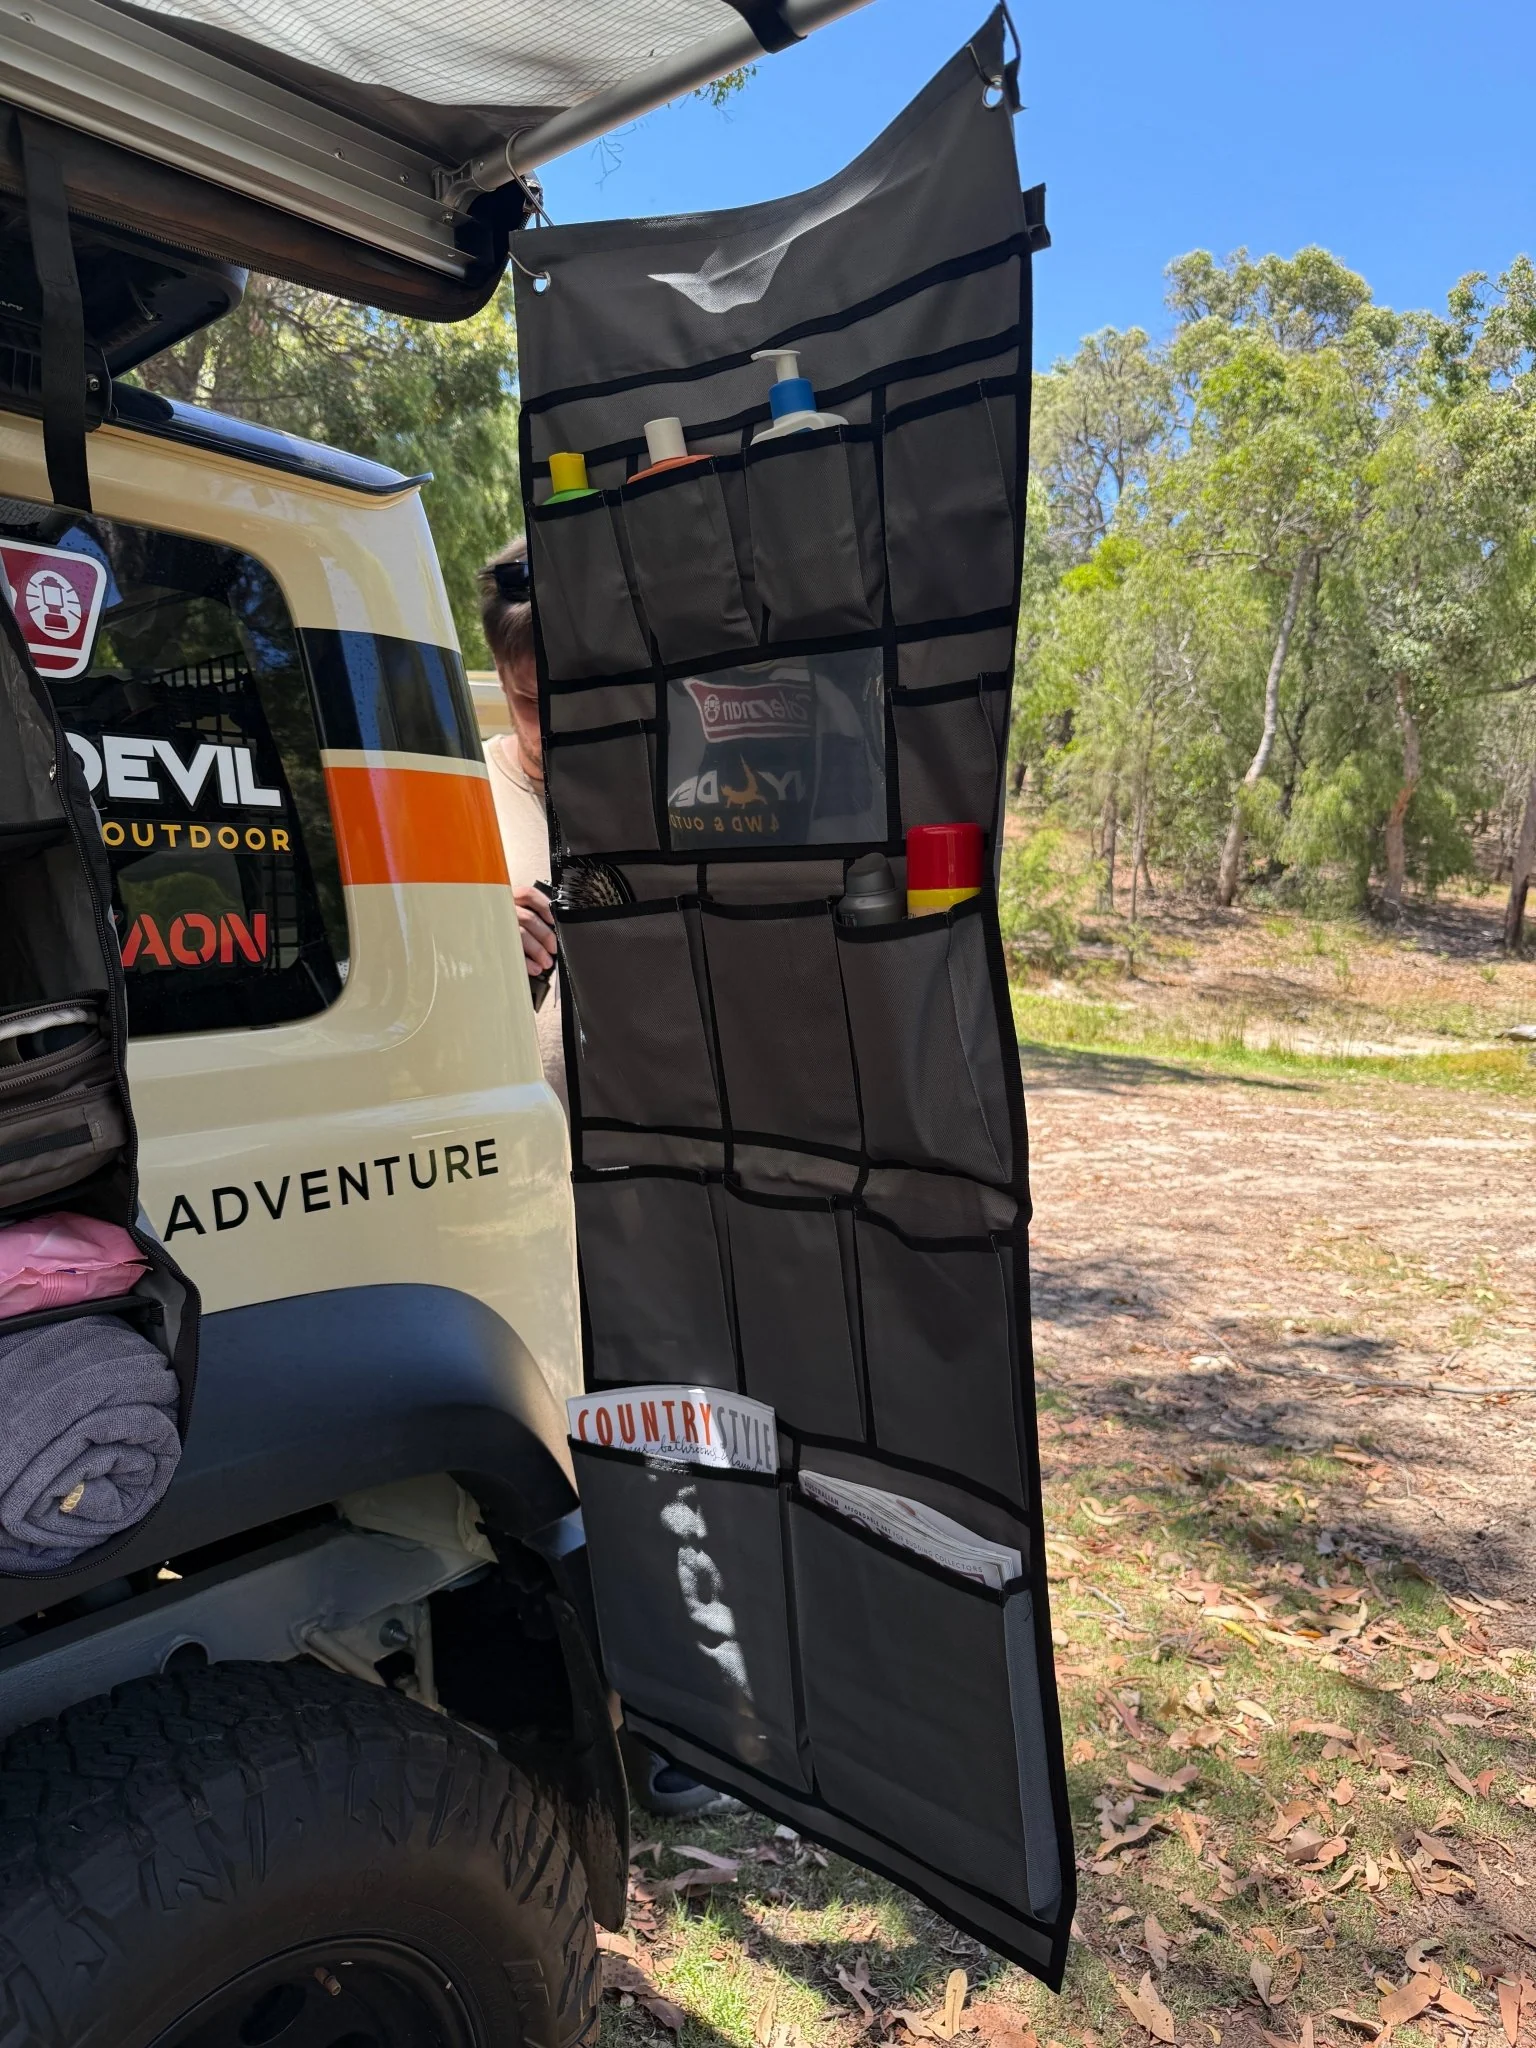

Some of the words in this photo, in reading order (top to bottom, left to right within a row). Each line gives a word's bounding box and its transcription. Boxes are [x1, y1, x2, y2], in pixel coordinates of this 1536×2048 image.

[104, 820, 291, 852] OUTDOOR
[114, 912, 268, 967] AON
[163, 1138, 499, 1242] ADVENTURE
[578, 1400, 711, 1446] COUNTRY
[716, 1406, 773, 1470] STYLE
[804, 1481, 839, 1506] AUSTRALIAN
[844, 1505, 879, 1527] AFFORDABLE
[881, 1524, 891, 1534] ART
[893, 1531, 904, 1541] FOR
[906, 1537, 933, 1557] BUDDING
[935, 1553, 983, 1573] COLLECTORS
